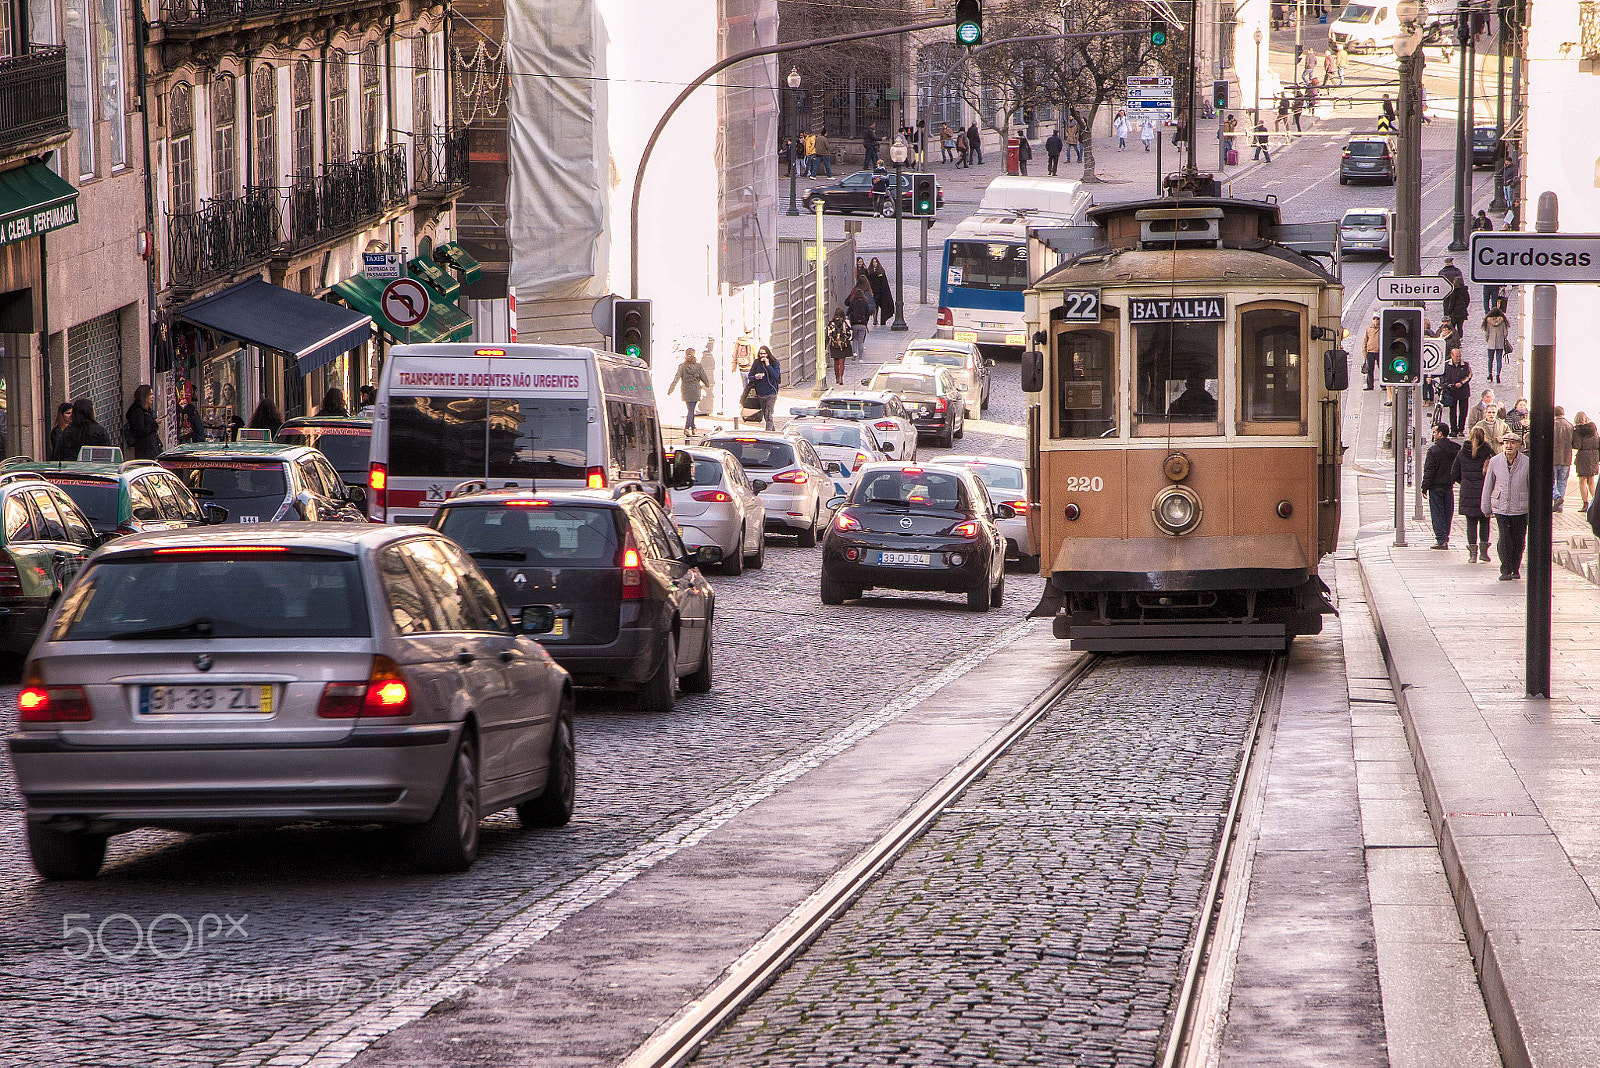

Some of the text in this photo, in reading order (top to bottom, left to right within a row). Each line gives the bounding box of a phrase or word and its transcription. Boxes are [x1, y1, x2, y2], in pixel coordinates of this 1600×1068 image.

[33, 203, 75, 232] PERFUMARIA
[1478, 247, 1591, 267] Cardosas
[1390, 283, 1440, 294] Ribeira
[1066, 293, 1098, 318] 22
[1132, 300, 1221, 319] BATALHA
[399, 372, 579, 388] TRANSPORTE DE DOENTES NÃO URGENTES
[1067, 476, 1104, 492] 220
